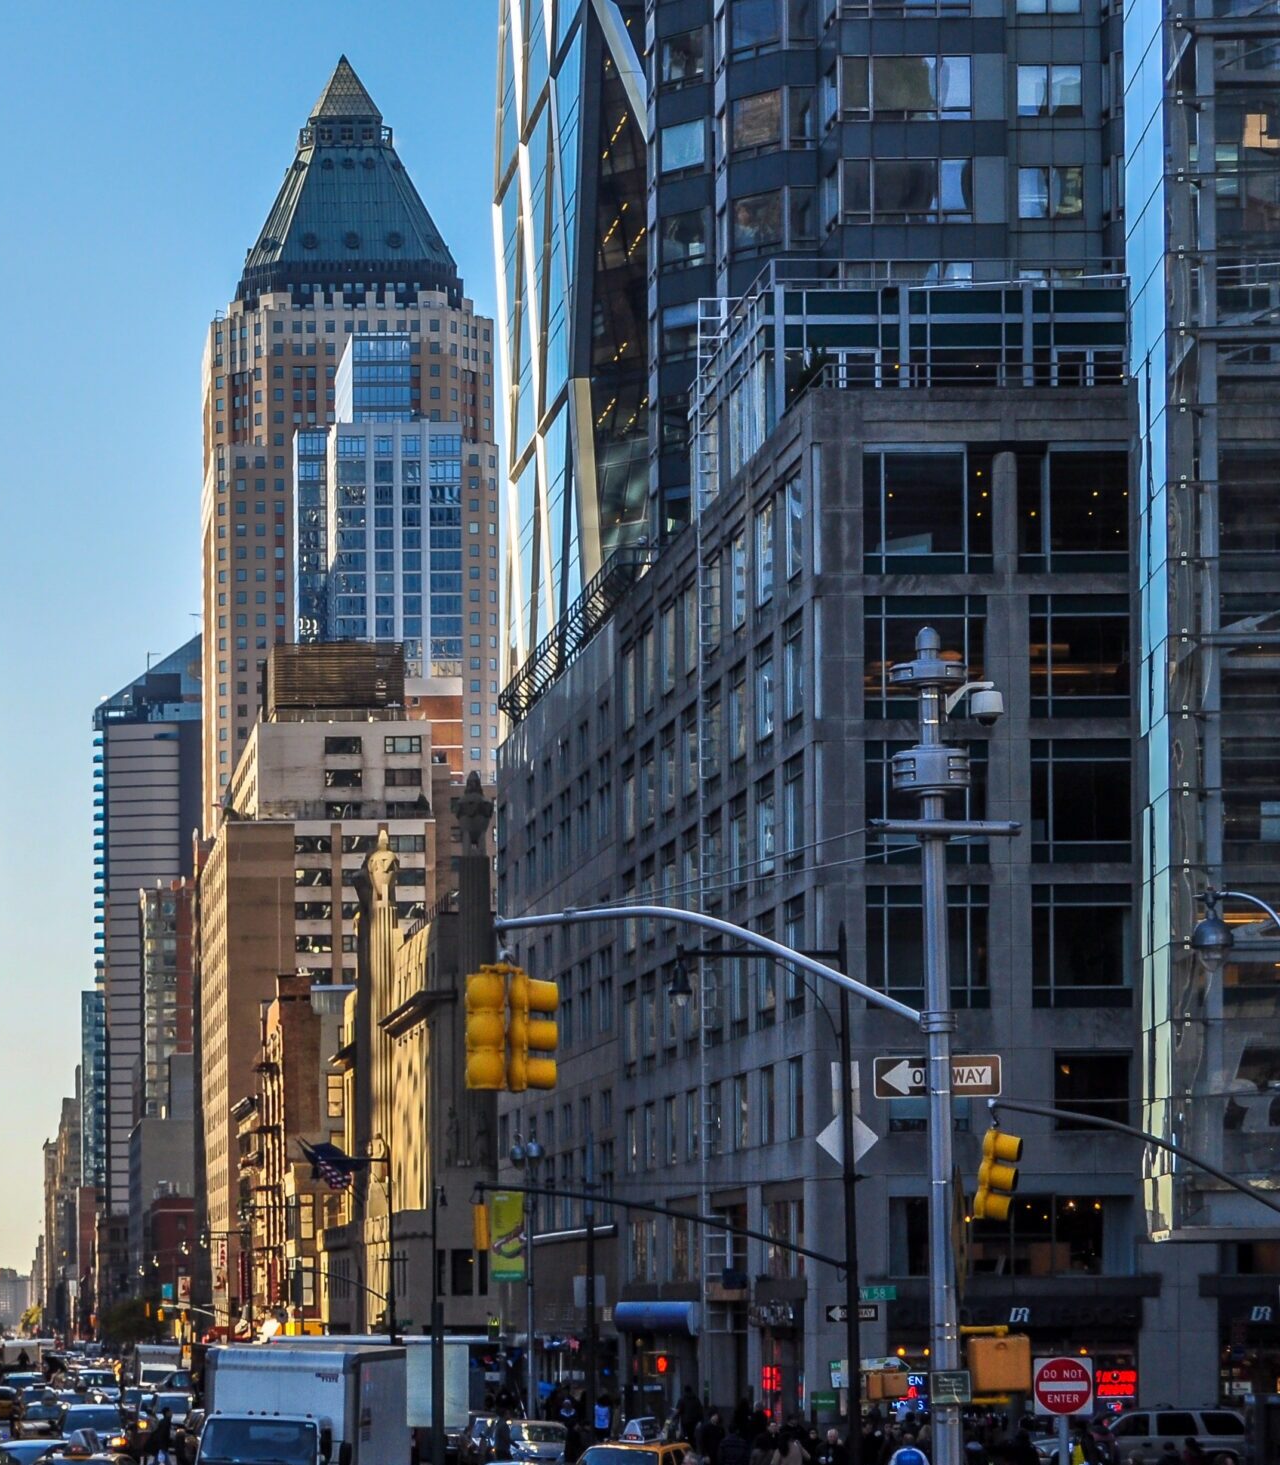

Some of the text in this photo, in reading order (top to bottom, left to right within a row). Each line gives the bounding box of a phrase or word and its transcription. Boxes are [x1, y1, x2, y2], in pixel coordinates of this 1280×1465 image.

[952, 1068, 987, 1084] WAY
[860, 1288, 886, 1299] W 58
[1043, 1369, 1083, 1379] DO NOT
[907, 1375, 923, 1386] EN
[1047, 1394, 1080, 1403] ENTER
[891, 1400, 924, 1411] HOS
